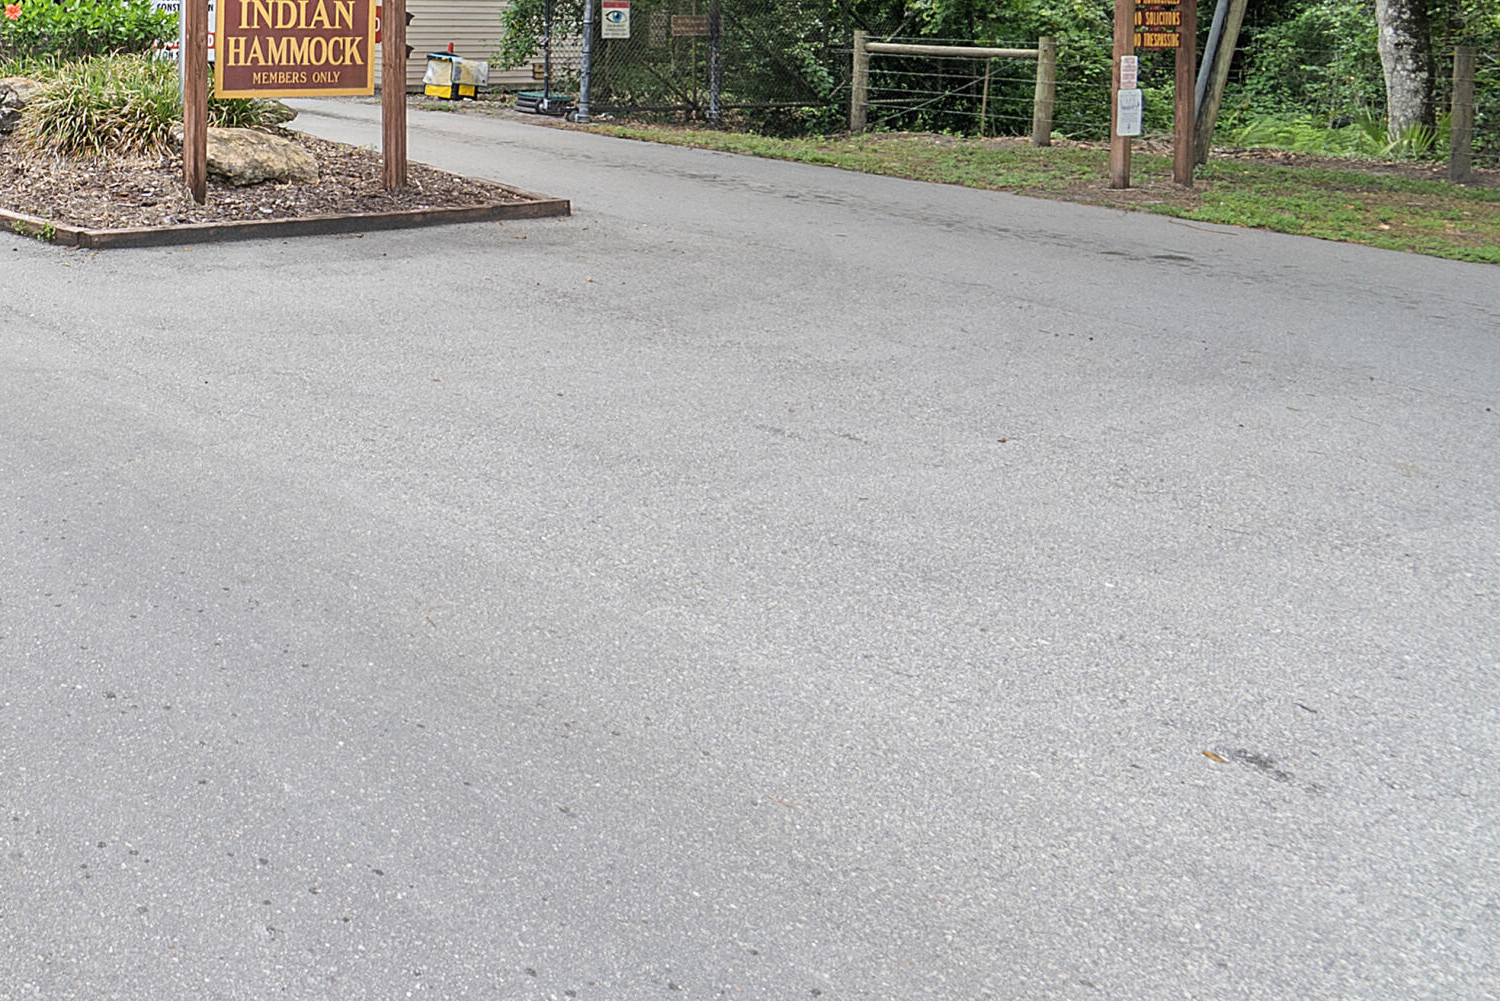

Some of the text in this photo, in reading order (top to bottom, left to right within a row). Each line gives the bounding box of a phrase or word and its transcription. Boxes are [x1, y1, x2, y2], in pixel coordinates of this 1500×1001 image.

[1145, 11, 1181, 26] SOLICITORS
[1143, 32, 1180, 47] TRESPASSING
[227, 35, 364, 67] HAMMOCK
[252, 71, 341, 85] MEMBERS ONLY
